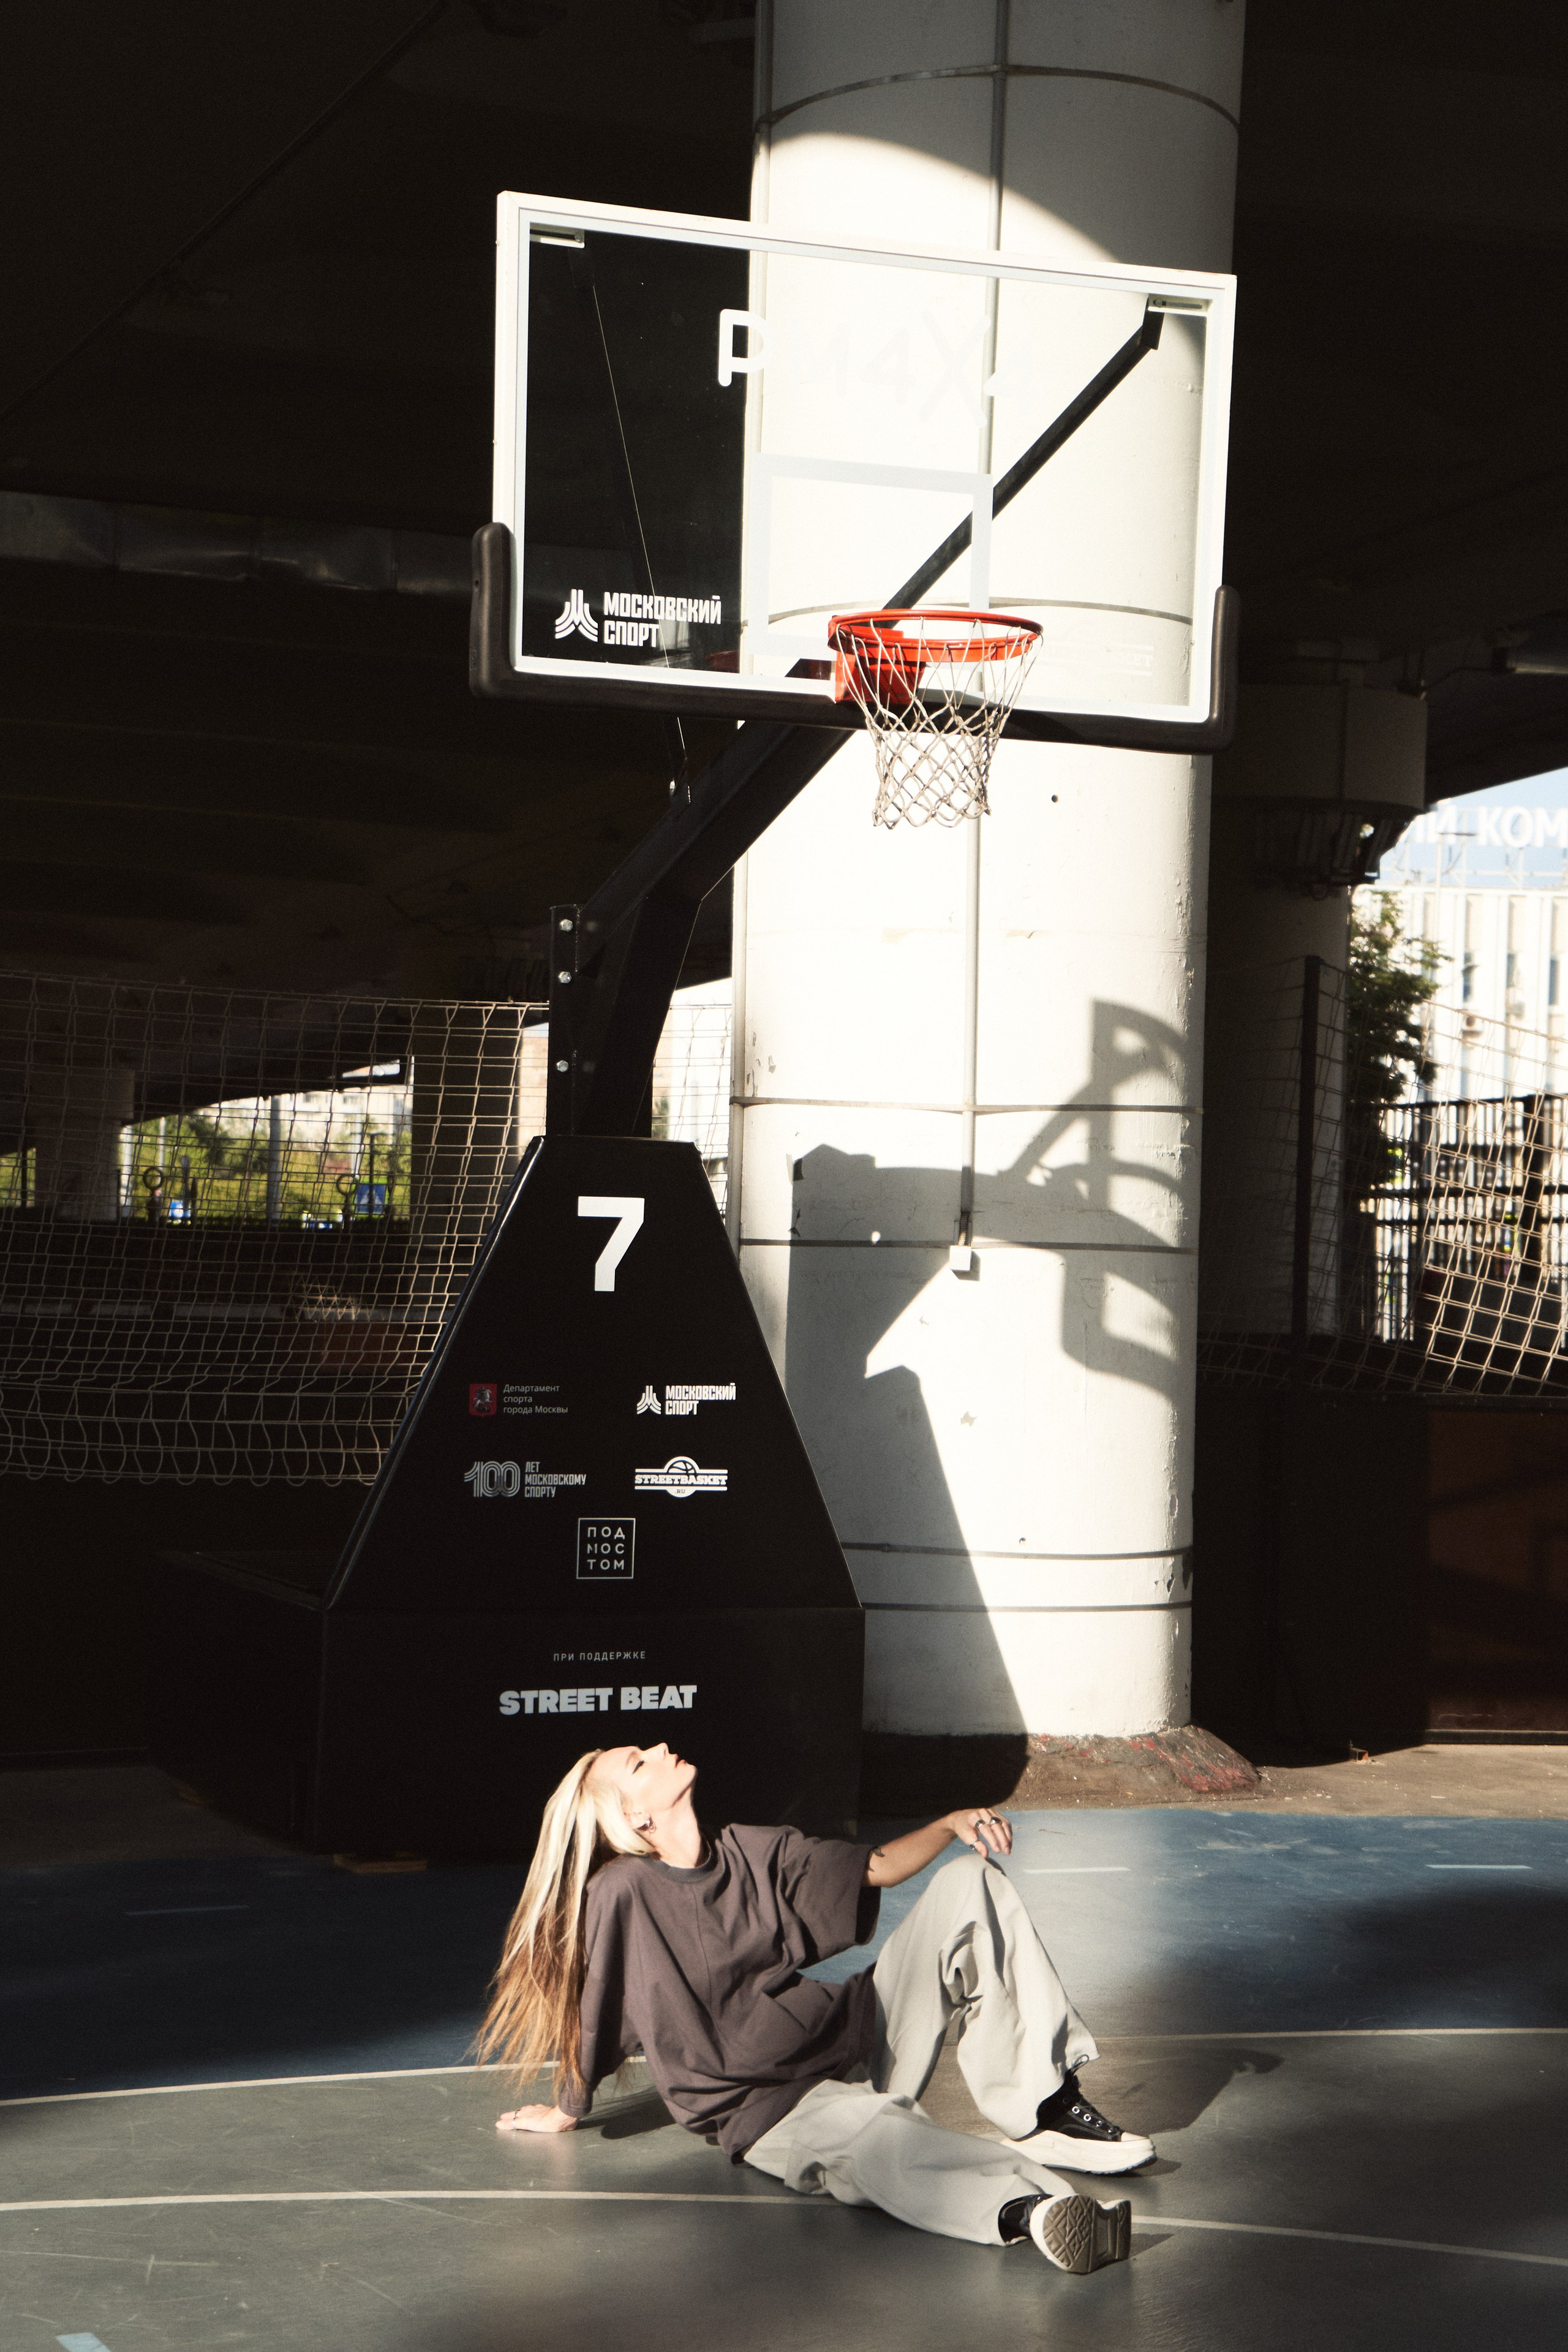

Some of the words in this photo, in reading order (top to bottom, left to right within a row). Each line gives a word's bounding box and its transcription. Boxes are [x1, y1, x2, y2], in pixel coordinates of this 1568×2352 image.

[604, 592, 722, 624] МОСКОВСКИЙ
[604, 620, 660, 647] СПОРТ
[578, 1196, 645, 1292] 7
[503, 1384, 560, 1393] Департамент
[665, 1382, 736, 1400] МОСКОВСКИЙ
[503, 1396, 533, 1404] спорта
[665, 1400, 699, 1415] СПОРТ
[525, 1461, 540, 1472] ЛЕТ
[464, 1461, 521, 1498] 100
[525, 1474, 587, 1485] МОСКОВСКОМУ
[635, 1474, 728, 1485] STREETBASKET
[524, 1487, 556, 1498] СПОРТУ
[588, 1526, 625, 1540] ПОД
[587, 1559, 625, 1570] ТОМ
[554, 1653, 575, 1662] ПРИ
[579, 1651, 646, 1662] ПОДДЕРЖКЕ
[499, 1687, 613, 1715] STREET
[620, 1685, 697, 1711] BEAT
